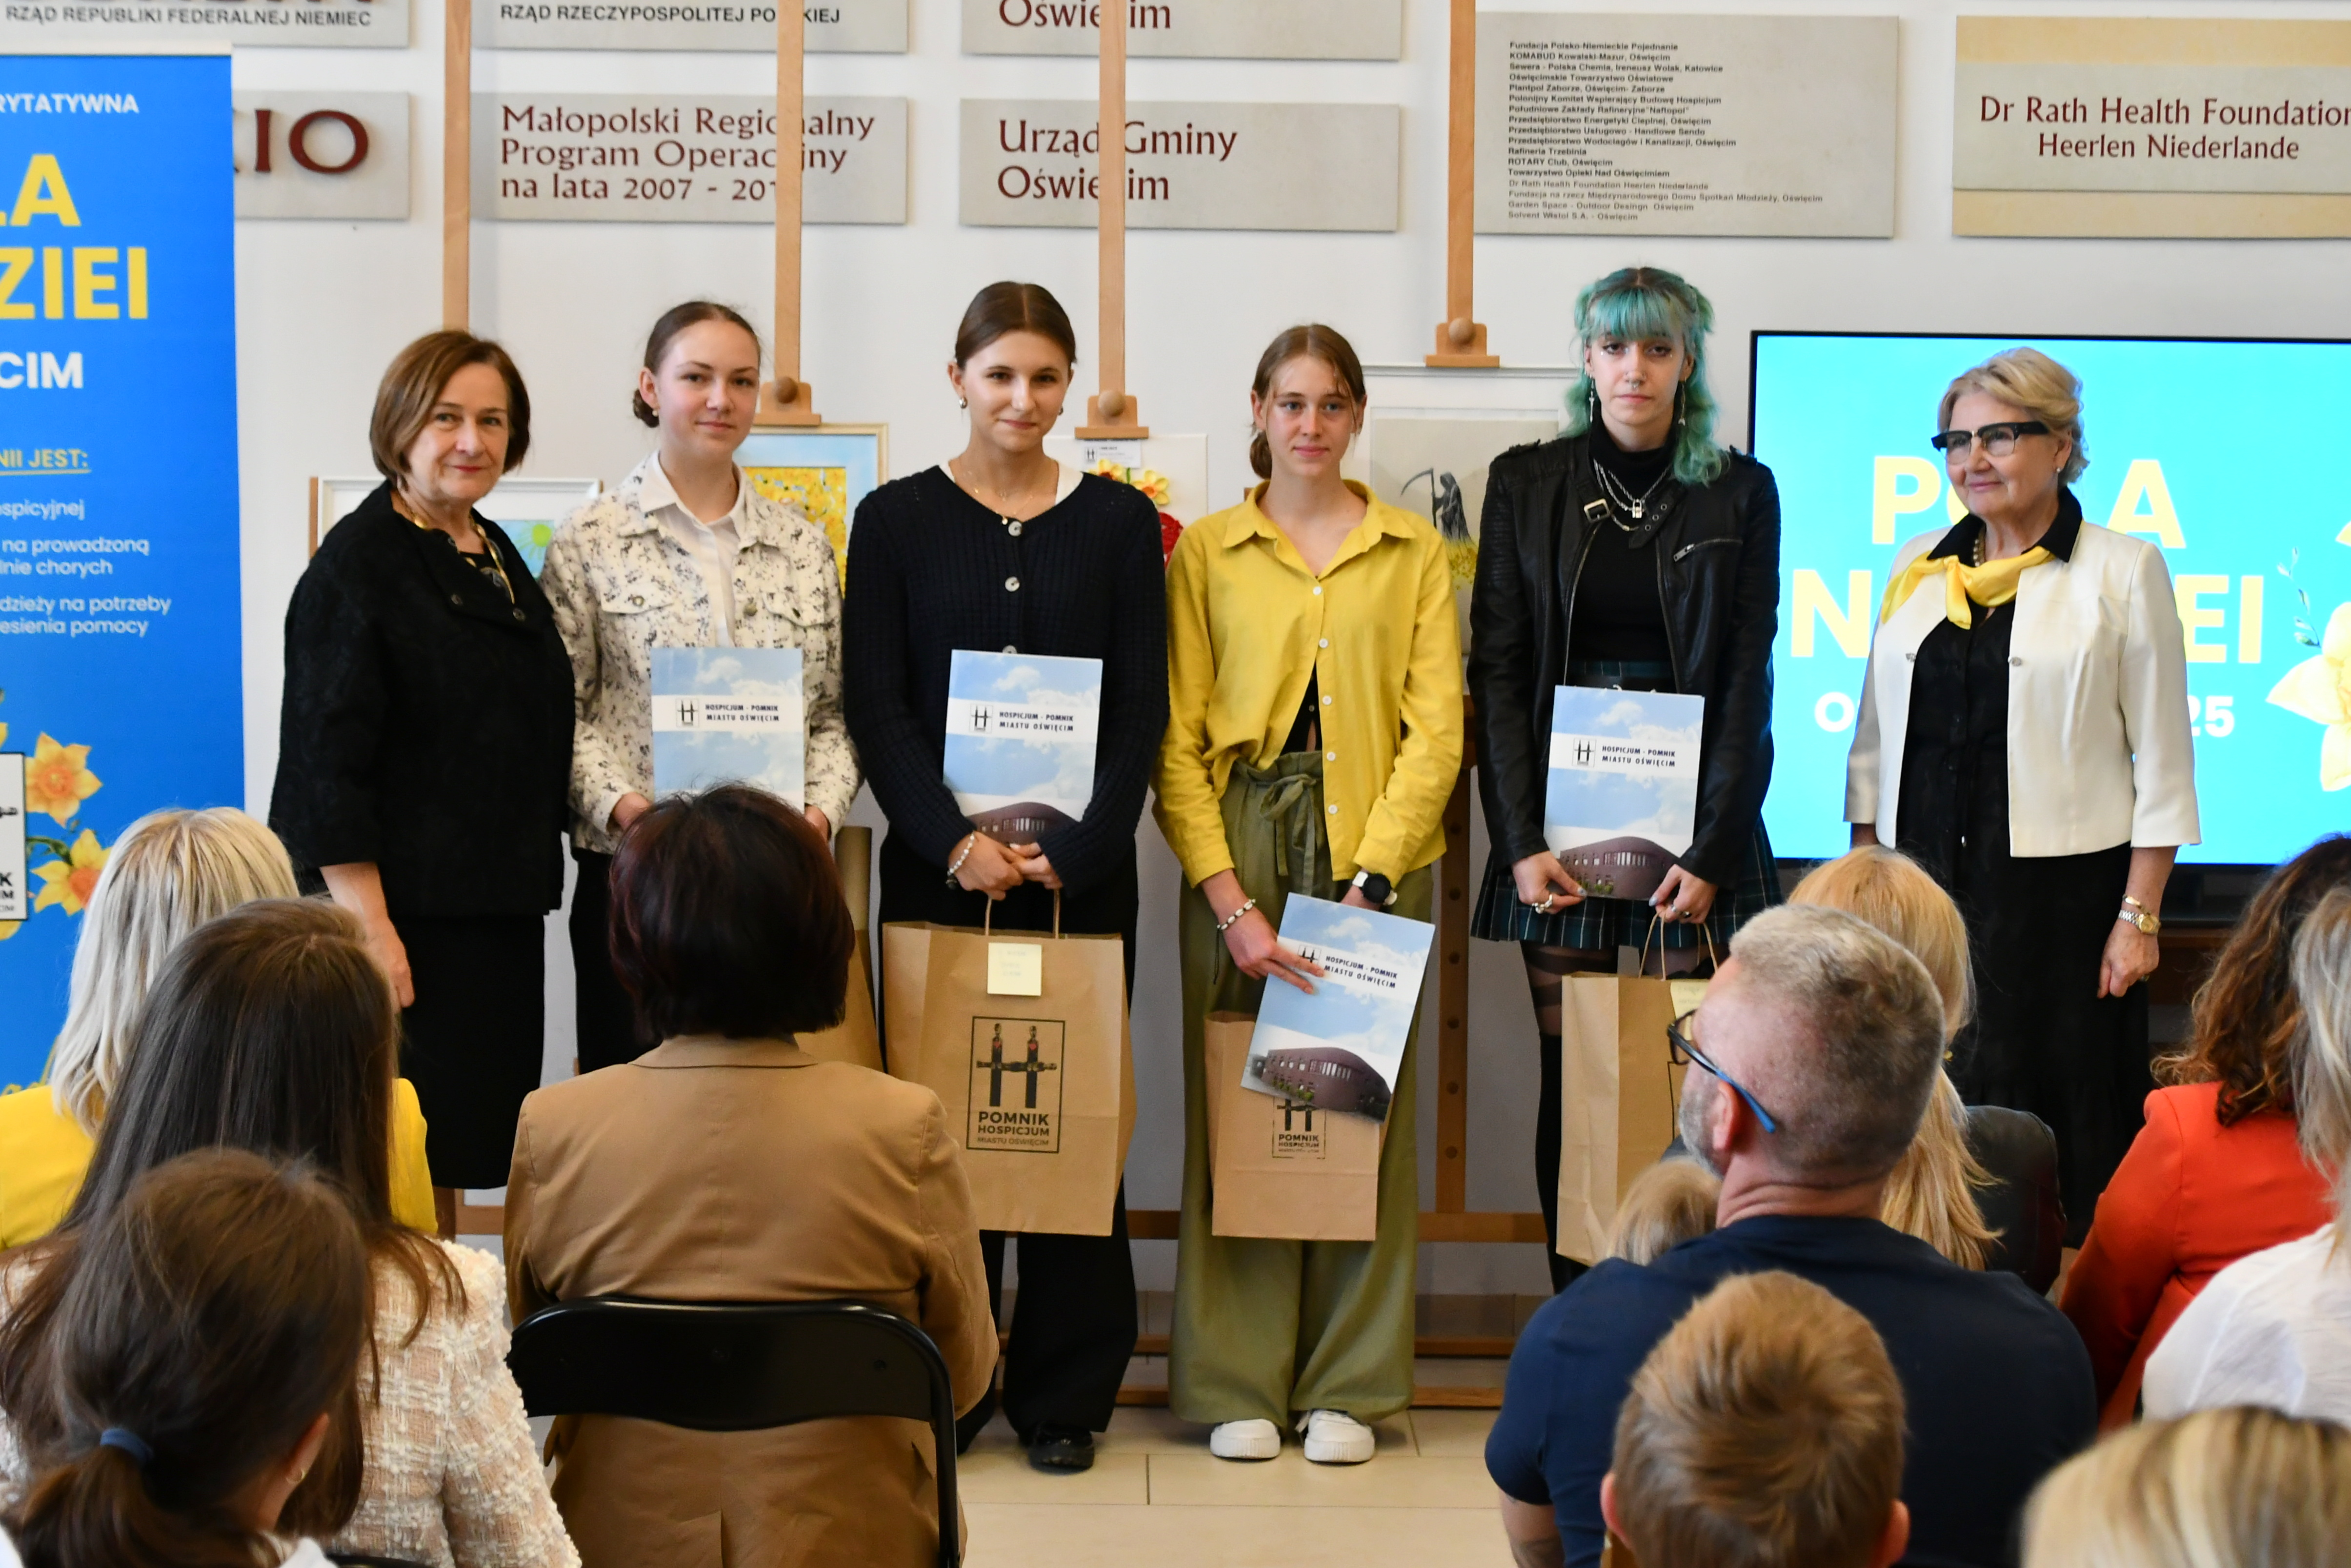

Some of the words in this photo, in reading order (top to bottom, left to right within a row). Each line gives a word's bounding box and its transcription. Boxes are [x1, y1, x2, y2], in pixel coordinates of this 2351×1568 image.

[6, 6, 57, 25] RZĄD
[63, 6, 161, 23] REPUBLIKI
[168, 8, 290, 25] FEDERALNEJ
[296, 11, 371, 26] NIEMIEC
[501, 6, 551, 23] RZĄD
[557, 6, 744, 22] RZECZYPOSPOLITEJ
[751, 8, 840, 23] POKIEJ
[1510, 42, 1548, 51] Fundacja
[1631, 43, 1678, 52] Pojednanie
[1629, 53, 1670, 61] Oświęcim
[1579, 63, 1613, 72] Chemia,
[1654, 64, 1682, 73] Wolak,
[1509, 73, 1567, 82] Oświęcimskie
[1570, 74, 1625, 83] Towarzystwo
[1628, 74, 1673, 82] Oświatowe
[1509, 84, 1544, 93] Plantpol
[1547, 84, 1582, 93] Zaborze,
[1509, 95, 1548, 103] Polonijny
[1587, 96, 1637, 104] Wspierający
[1640, 96, 1674, 105] Budowę
[1677, 96, 1721, 105] Hospicjum
[1562, 105, 1595, 114] Zakłady
[1981, 96, 2014, 122] Dr
[2027, 97, 2088, 123] Rath
[2101, 97, 2190, 125] Health
[502, 105, 680, 138] Małopolski
[1509, 116, 1581, 125] Przedsiębiorstwo
[1585, 117, 1628, 125] Energetyki
[1631, 117, 1668, 126] Cieplnej,
[1671, 116, 1711, 126] Oświęcim
[1509, 126, 1581, 135] Przedsiębiorstwo
[1584, 127, 1627, 136] Usługowo
[1000, 119, 1099, 158] Urząd
[1124, 121, 1238, 161] Gminy
[1508, 137, 1581, 146] Przedsiębiorstwo
[1645, 139, 1693, 147] Kanalizacji,
[1695, 138, 1736, 147] Oświęcim
[2038, 133, 2136, 158] Heerlen
[2147, 134, 2300, 160] Niederlande
[502, 139, 640, 170] Program
[655, 140, 847, 174] Operacjny
[1547, 159, 1569, 167] Club,
[1572, 158, 1613, 167] Oświęcim
[1508, 168, 1563, 177] Towarzystwo
[1566, 169, 1592, 178] Opieki
[1614, 169, 1670, 179] Oświęcimiem
[502, 176, 538, 199] na
[554, 174, 608, 199] lata
[624, 179, 692, 200] 2007
[1509, 190, 1547, 200] Fundacja
[1587, 192, 1668, 201] Międzynarodowego
[1542, 201, 1567, 210] Space
[28, 449, 88, 468] JEST:
[0, 499, 85, 521] spicyjnej
[2, 539, 27, 553] na
[32, 537, 150, 557] prowadzoną
[36, 559, 113, 579] chorych
[60, 598, 85, 611] na
[89, 595, 171, 615] potrzeby
[70, 620, 149, 638] pomocy
[740, 714, 779, 723] OŚWIĘCIM
[1033, 722, 1073, 732] OŚWIĘCIM
[1602, 746, 1641, 754] HOSPICJUM
[1635, 756, 1675, 767] OŚWIĘCIM
[1326, 956, 1364, 970] HOSPICJUM
[1370, 967, 1397, 979] POMNIK
[1325, 965, 1353, 977] MIASTU
[1357, 973, 1396, 988] OŚWIĘCIM
[979, 1111, 1049, 1126] POMNIK
[978, 1125, 1049, 1137] HOSPICJUM
[1279, 1134, 1319, 1142] POMNIK
